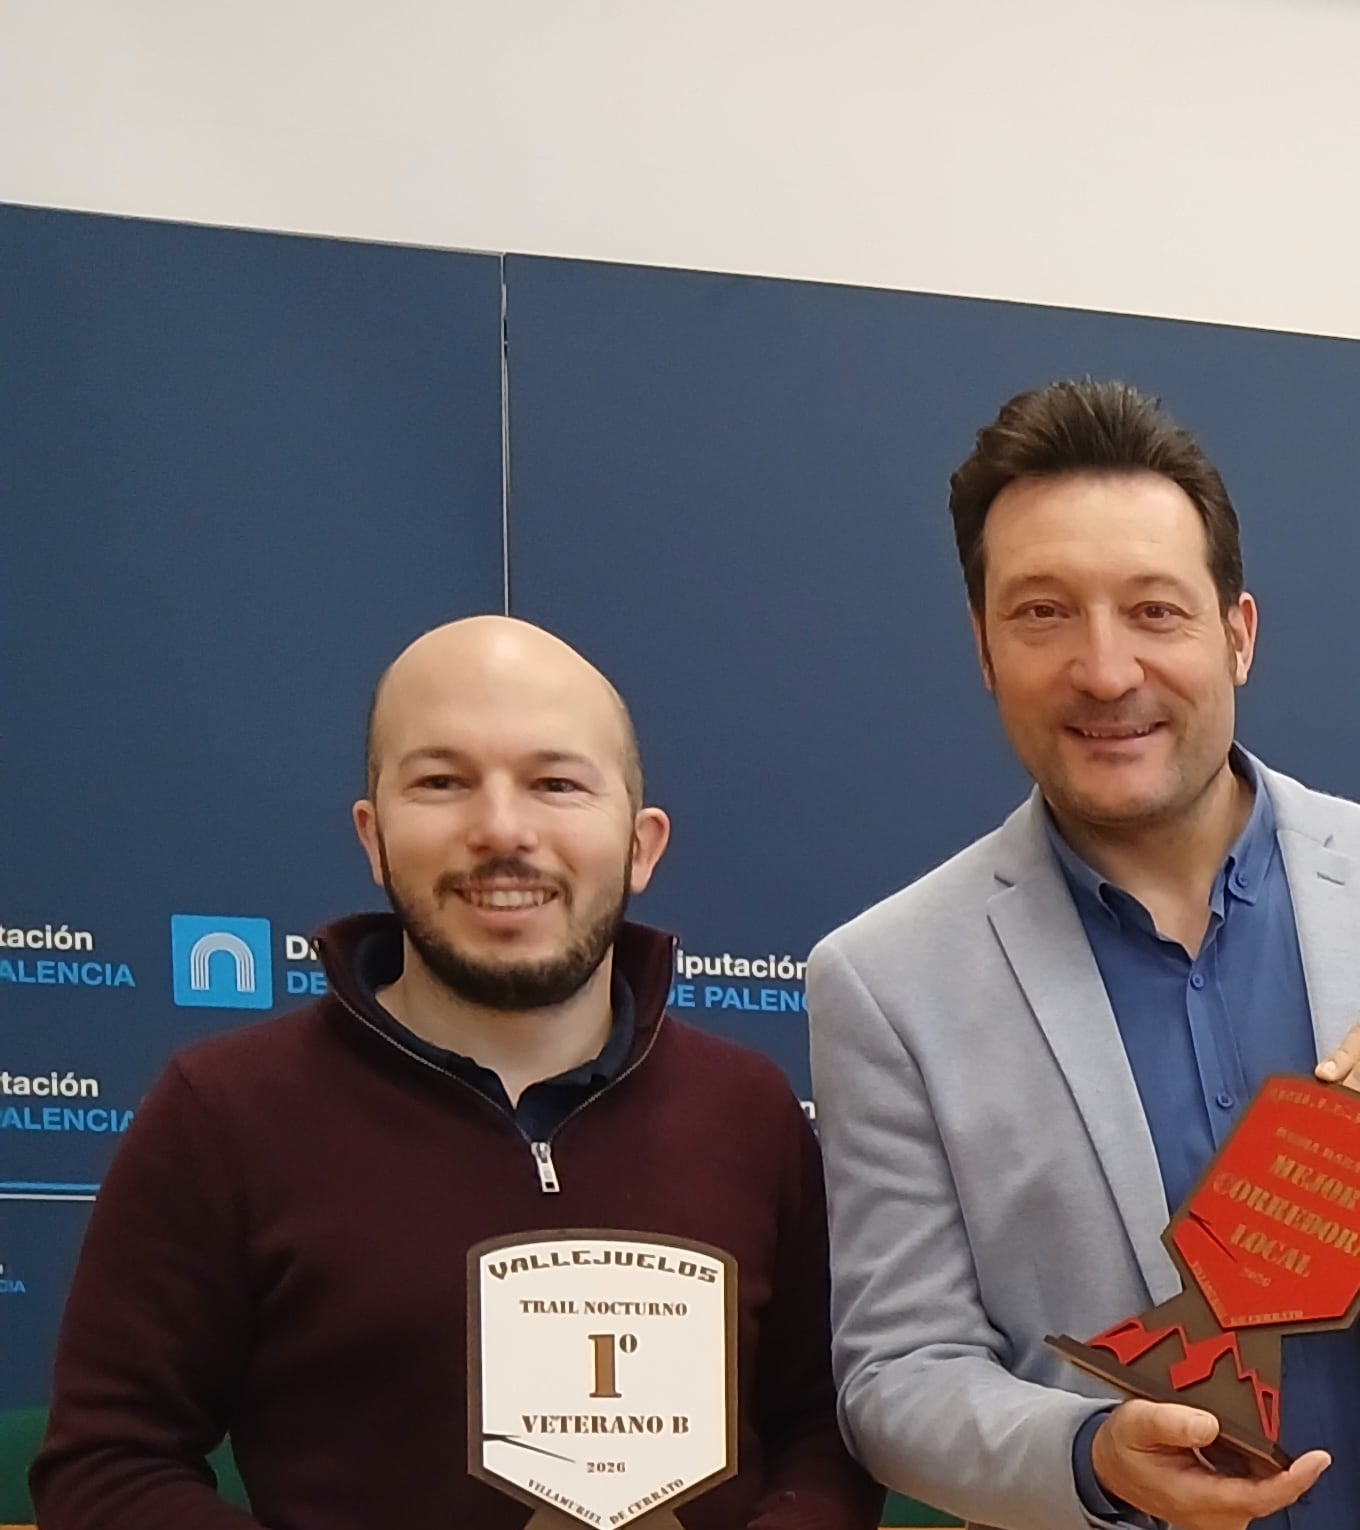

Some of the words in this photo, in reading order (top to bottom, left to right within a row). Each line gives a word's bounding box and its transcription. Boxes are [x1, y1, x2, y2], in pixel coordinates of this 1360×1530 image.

[705, 986, 808, 1012] PALEN
[1229, 1223, 1313, 1278] LOCAL
[488, 1250, 718, 1284] VALLEJUELOS
[520, 1300, 579, 1315] TRAIL
[583, 1301, 688, 1317] NOCTURNO
[522, 1415, 663, 1434] VETERANO
[672, 1416, 689, 1434] B
[586, 1462, 626, 1473] 2026
[528, 1479, 602, 1524] VILLAMURIEL
[609, 1509, 627, 1525] DE
